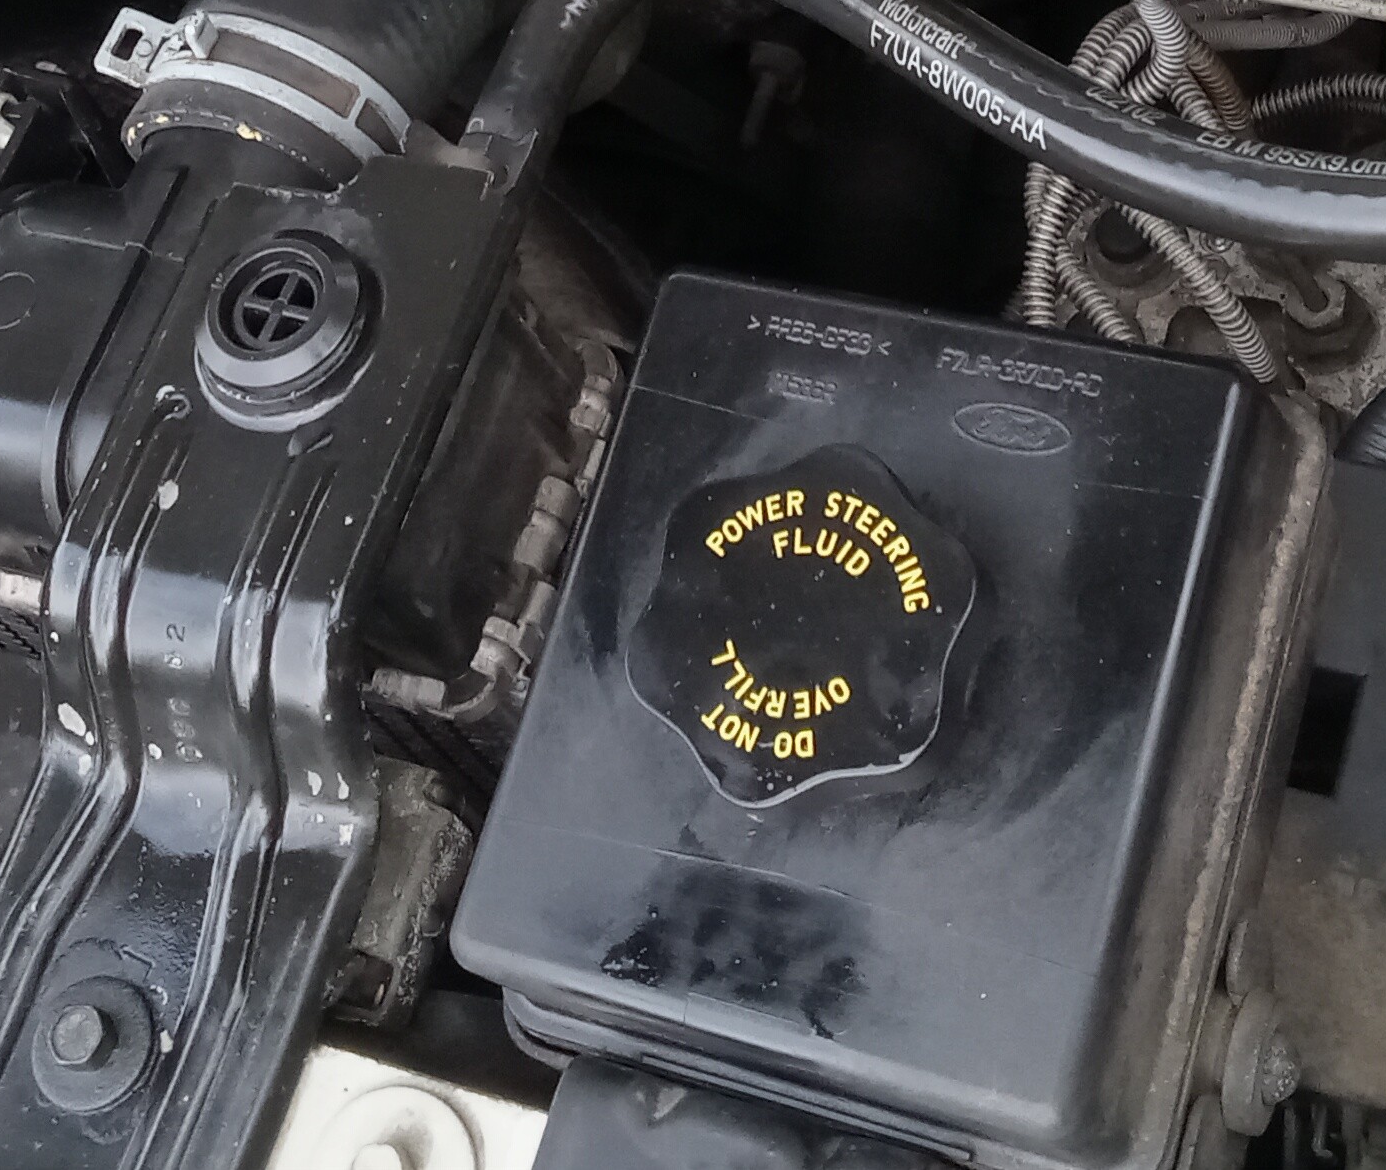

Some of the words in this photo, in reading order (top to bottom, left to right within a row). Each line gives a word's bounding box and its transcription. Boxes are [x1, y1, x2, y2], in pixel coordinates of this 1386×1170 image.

[869, 19, 1048, 151] F7UA-8W005-AA
[705, 489, 806, 558] POWER
[823, 491, 931, 614] STEERING
[772, 527, 872, 577] FLUID
[711, 638, 852, 720] OVERFILL
[700, 703, 761, 753] NOT
[773, 729, 815, 760] DO
